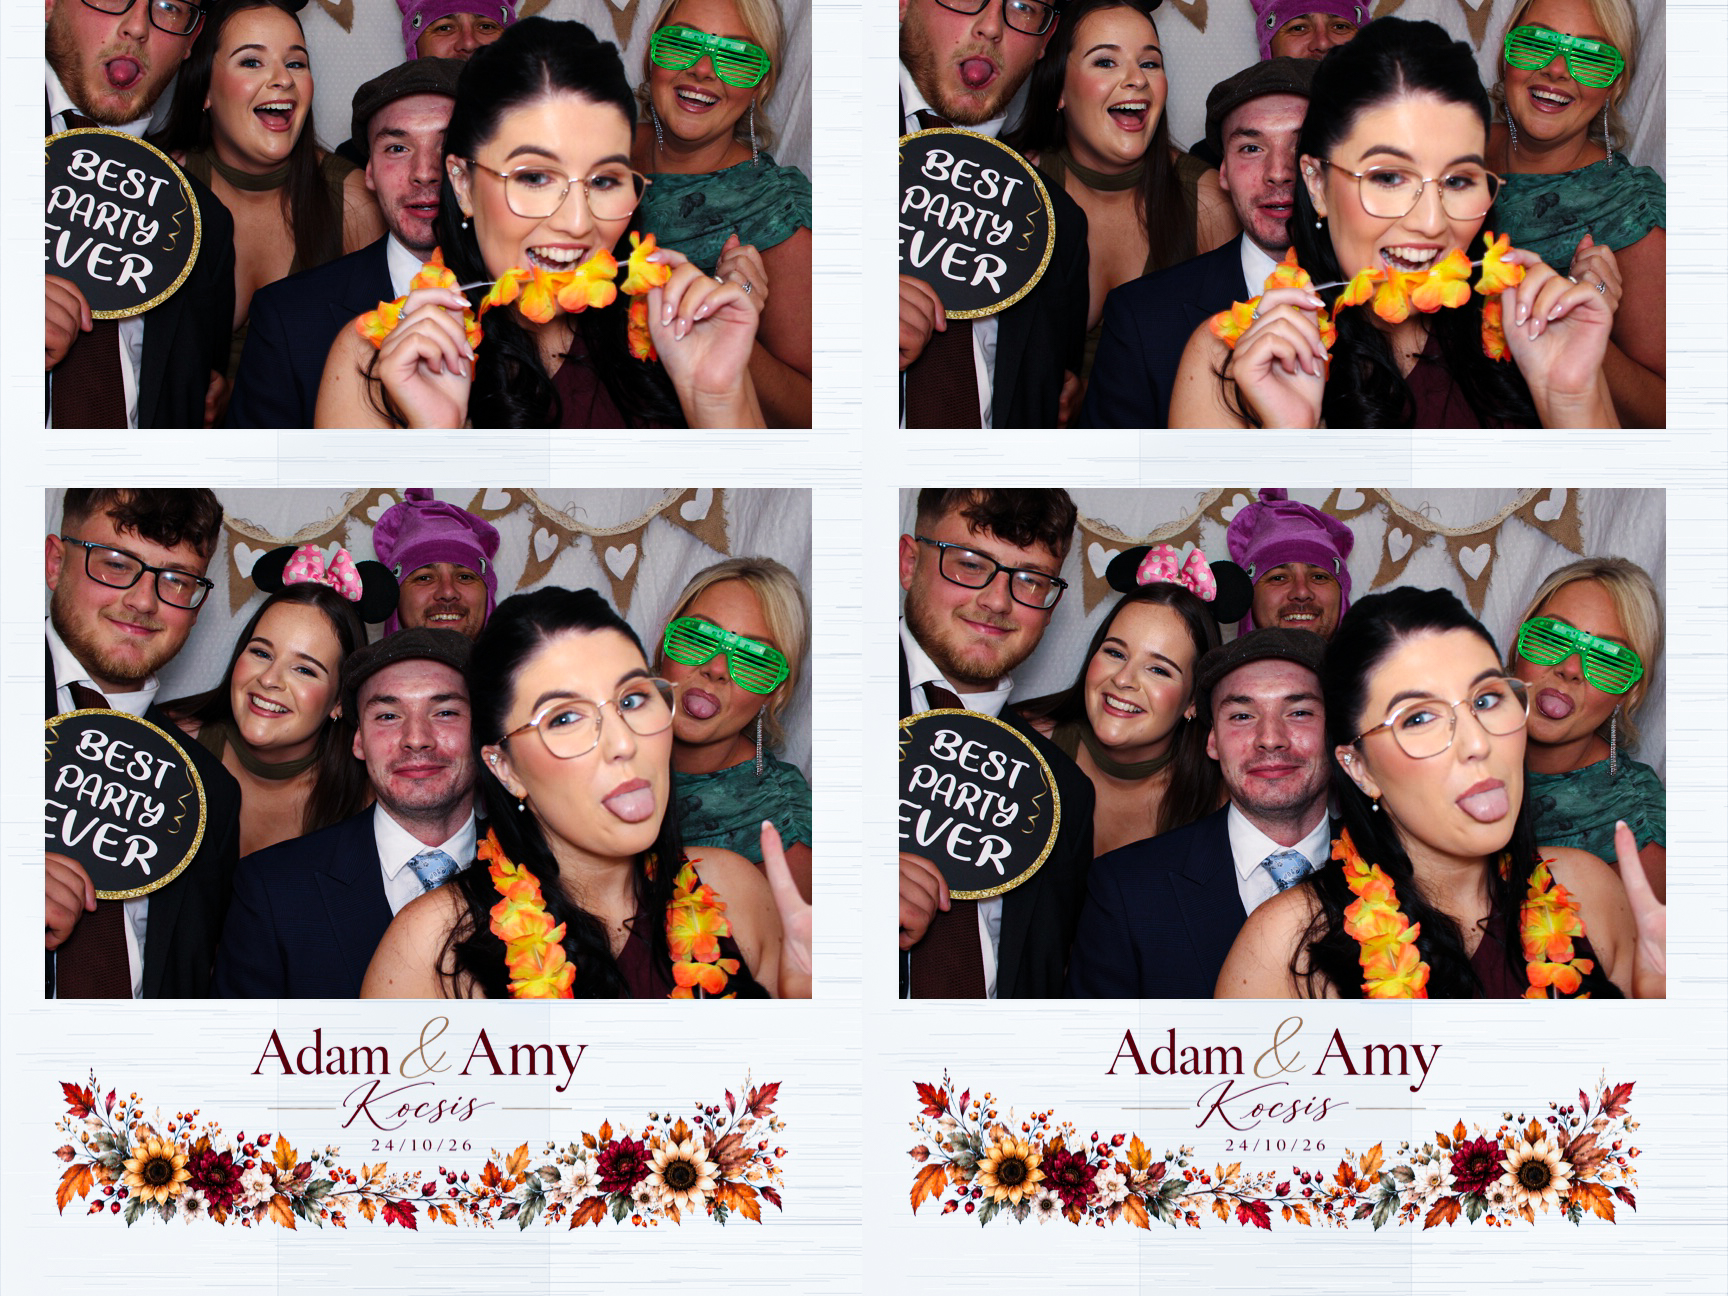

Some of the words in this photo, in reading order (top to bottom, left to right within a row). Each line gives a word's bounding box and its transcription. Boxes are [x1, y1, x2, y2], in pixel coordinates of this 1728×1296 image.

[67, 149, 170, 207] BEST
[921, 149, 1024, 207] BEST
[47, 185, 159, 246] PARTY
[901, 185, 1013, 246] PARTY
[75, 729, 176, 789] BEST
[929, 729, 1030, 789] BEST
[54, 764, 165, 828] PARTY
[908, 764, 1019, 828] PARTY
